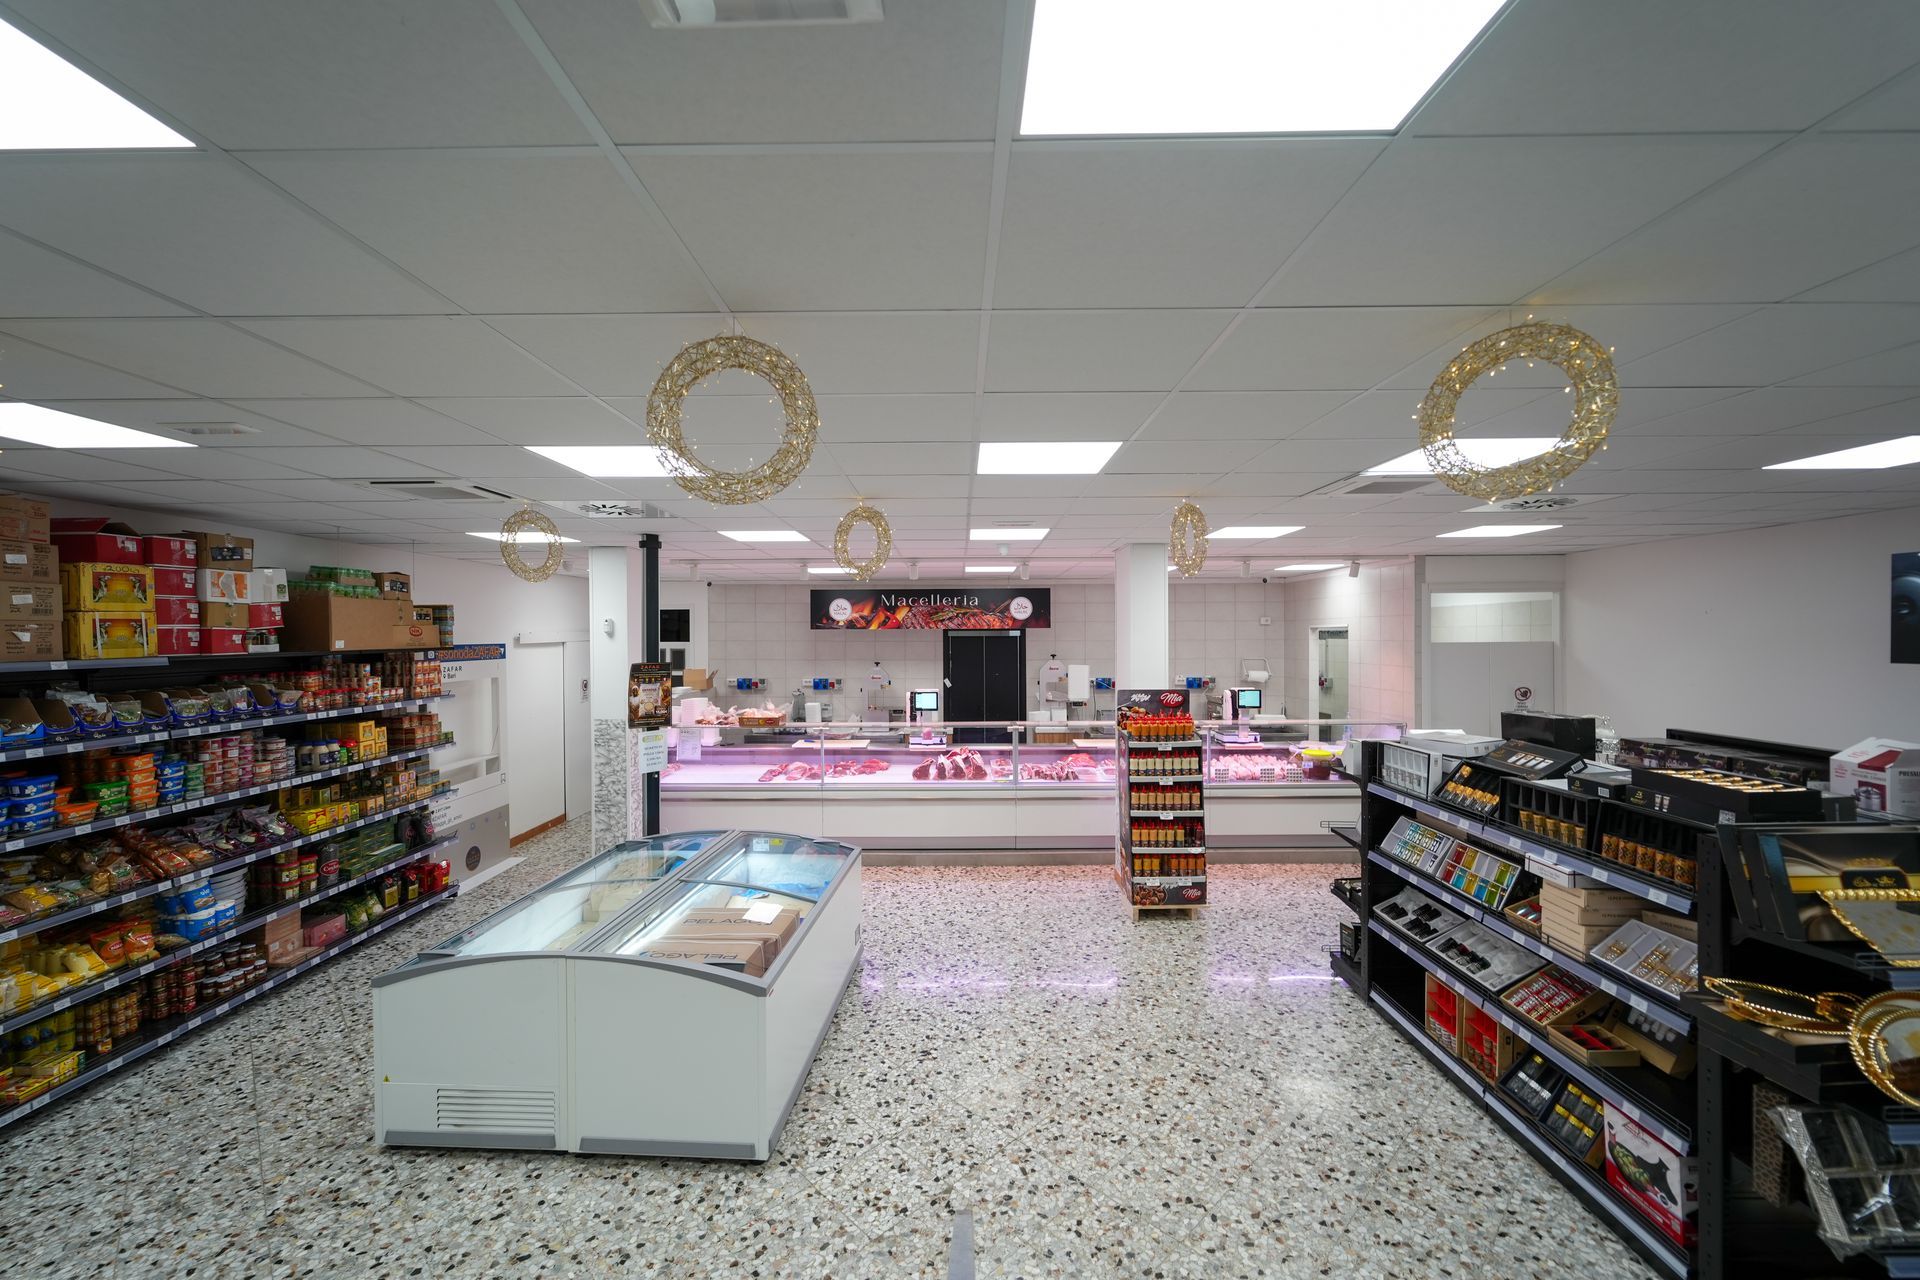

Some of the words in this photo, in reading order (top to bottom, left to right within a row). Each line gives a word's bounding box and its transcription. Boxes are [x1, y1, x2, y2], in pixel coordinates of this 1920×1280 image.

[881, 593, 978, 607] Macelleria
[1160, 692, 1184, 705] Mia
[1182, 888, 1202, 899] Mia
[649, 952, 739, 960] PELAGO
